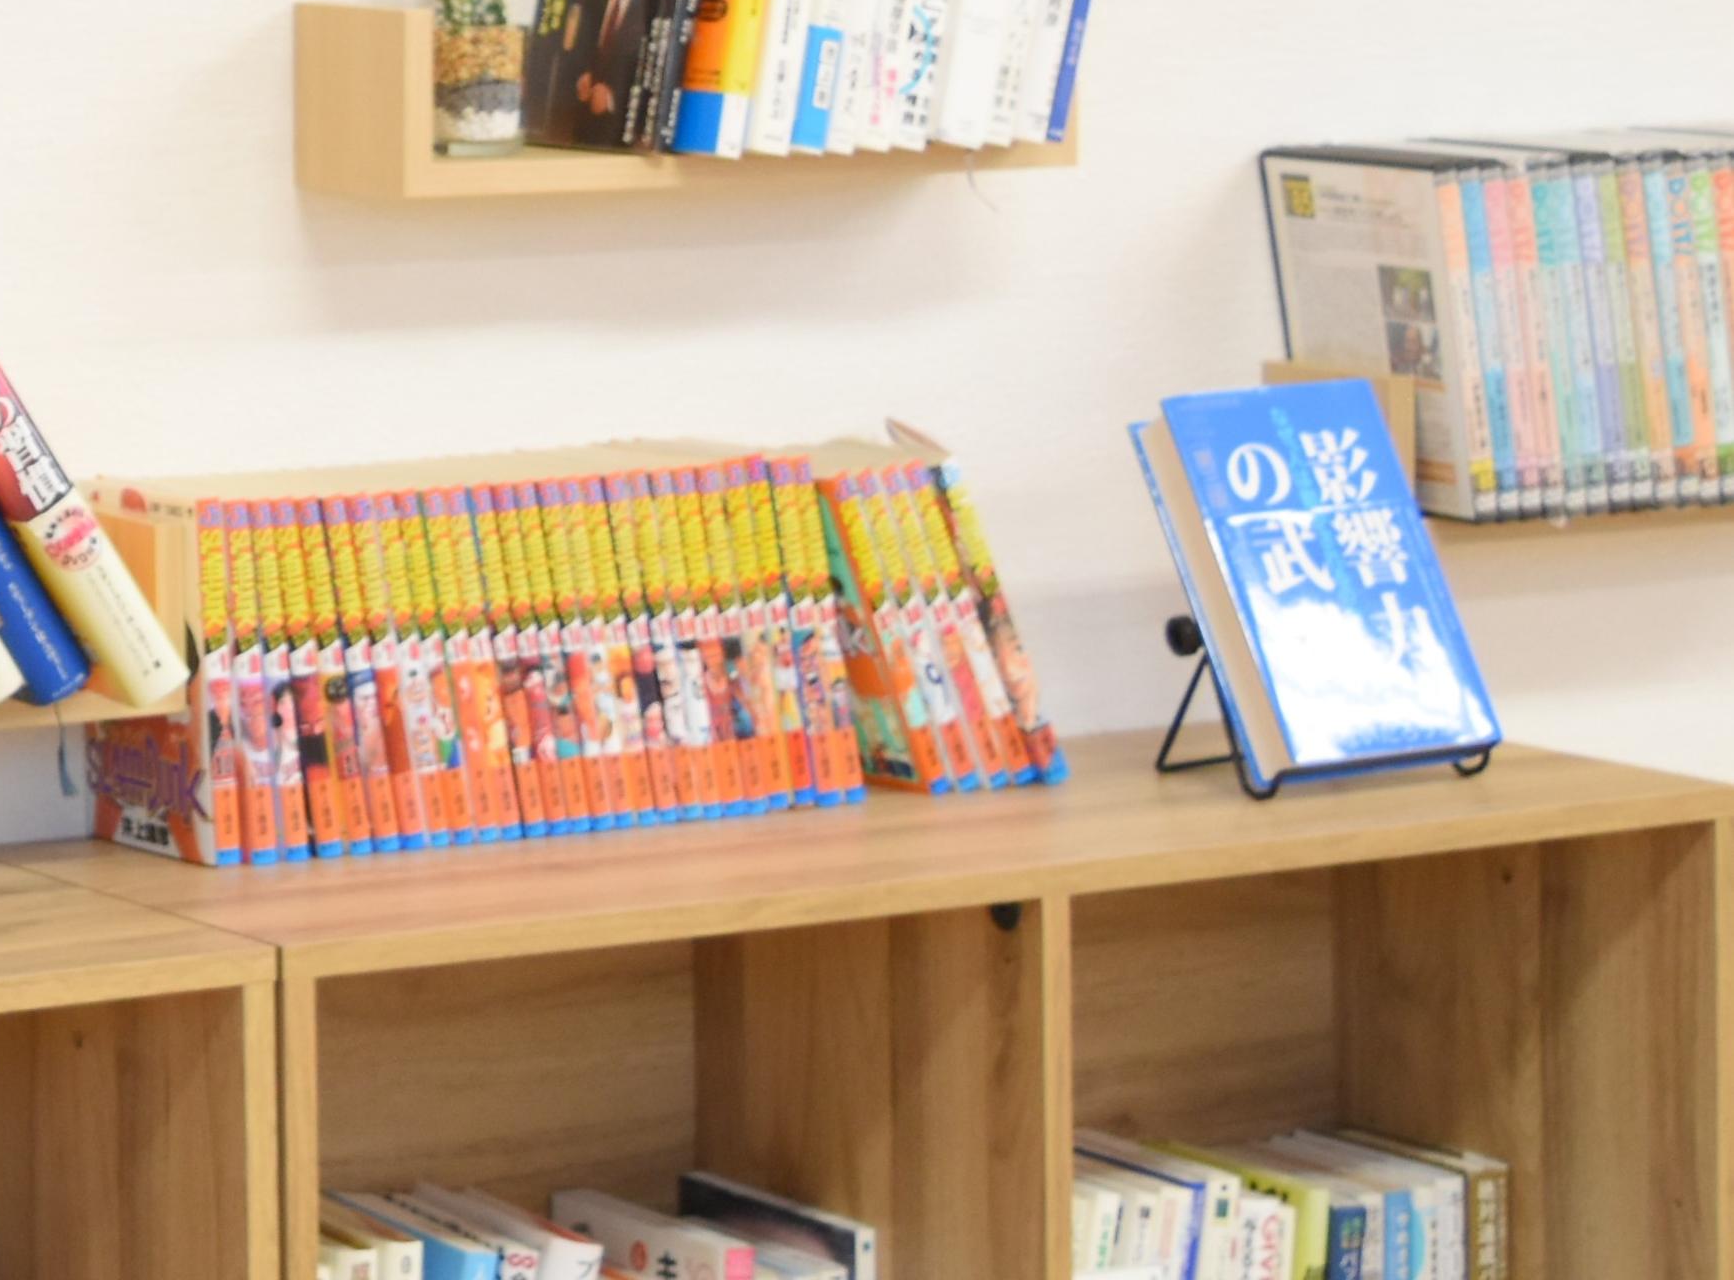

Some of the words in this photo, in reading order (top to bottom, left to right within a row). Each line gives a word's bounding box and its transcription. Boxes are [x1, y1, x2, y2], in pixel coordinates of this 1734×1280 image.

[1226, 442, 1337, 595] の武
[1297, 427, 1436, 669] 影響力
